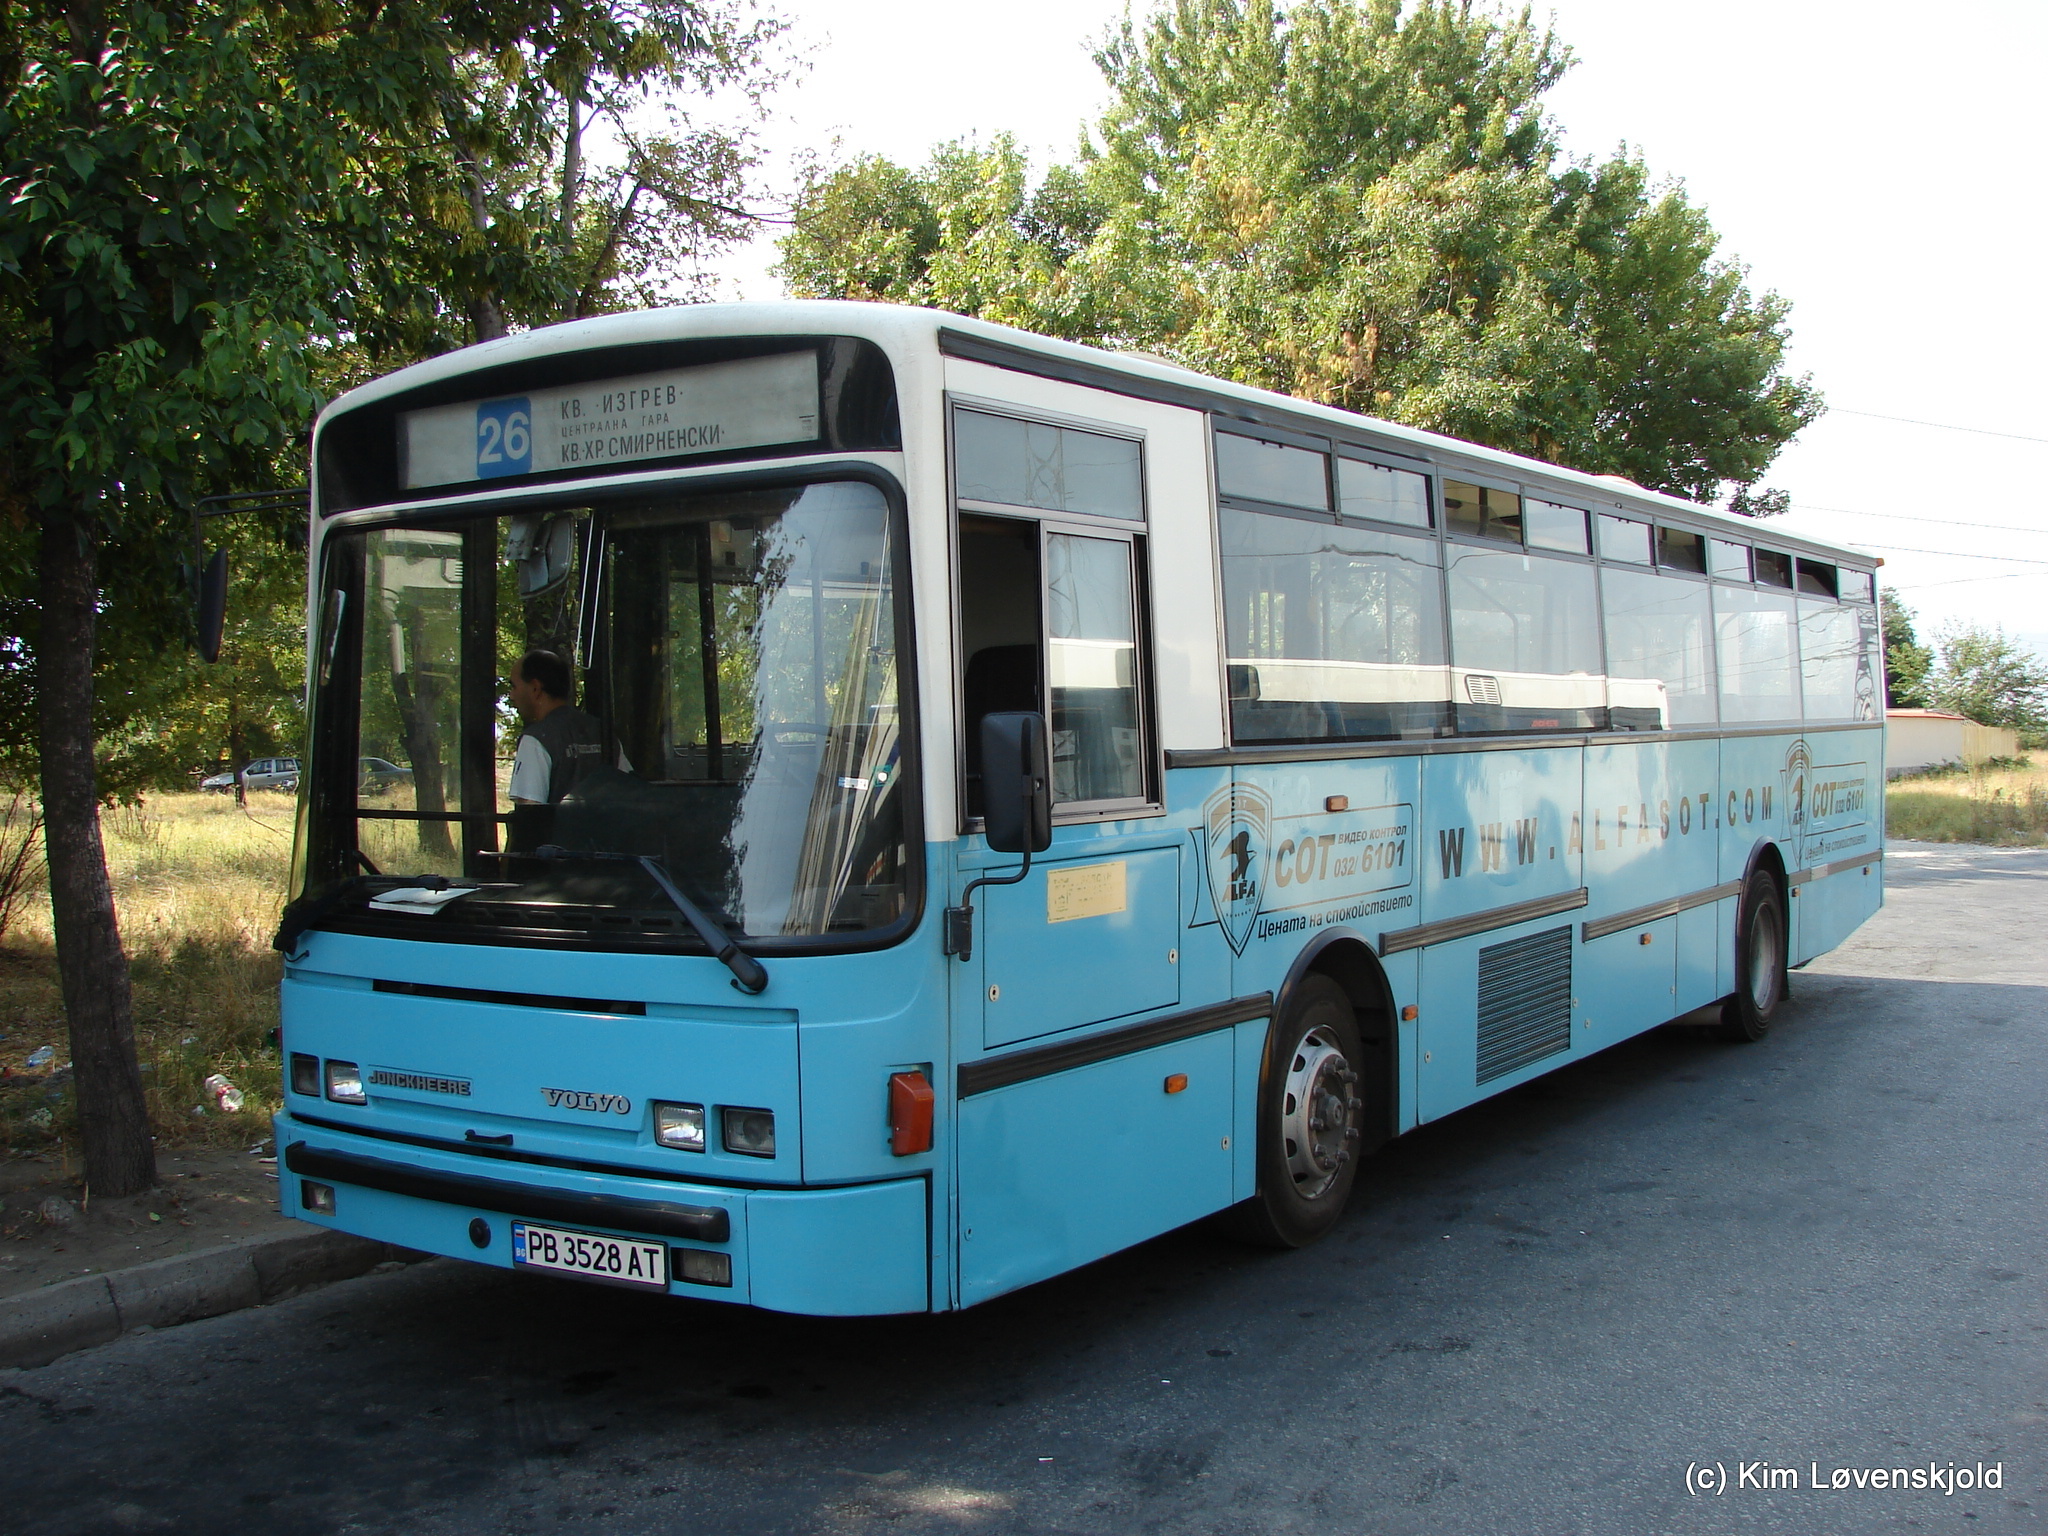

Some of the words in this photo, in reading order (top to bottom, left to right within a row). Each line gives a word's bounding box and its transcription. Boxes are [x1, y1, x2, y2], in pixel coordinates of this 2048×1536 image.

[561, 399, 586, 420] КВ.
[641, 413, 670, 427] ГАРА
[477, 411, 531, 465] 26
[1338, 830, 1368, 845] ВИДЕО
[1369, 825, 1407, 840] КОНТРОЛ
[1361, 839, 1405, 873] 6101
[1257, 915, 1307, 942] Цената
[1309, 913, 1323, 928] на
[1326, 894, 1413, 924] спокойствието
[367, 1070, 472, 1097] JONCKHEERE
[541, 1087, 631, 1115] VOLVO
[515, 1246, 526, 1258] BG
[563, 1236, 622, 1273] 3528
